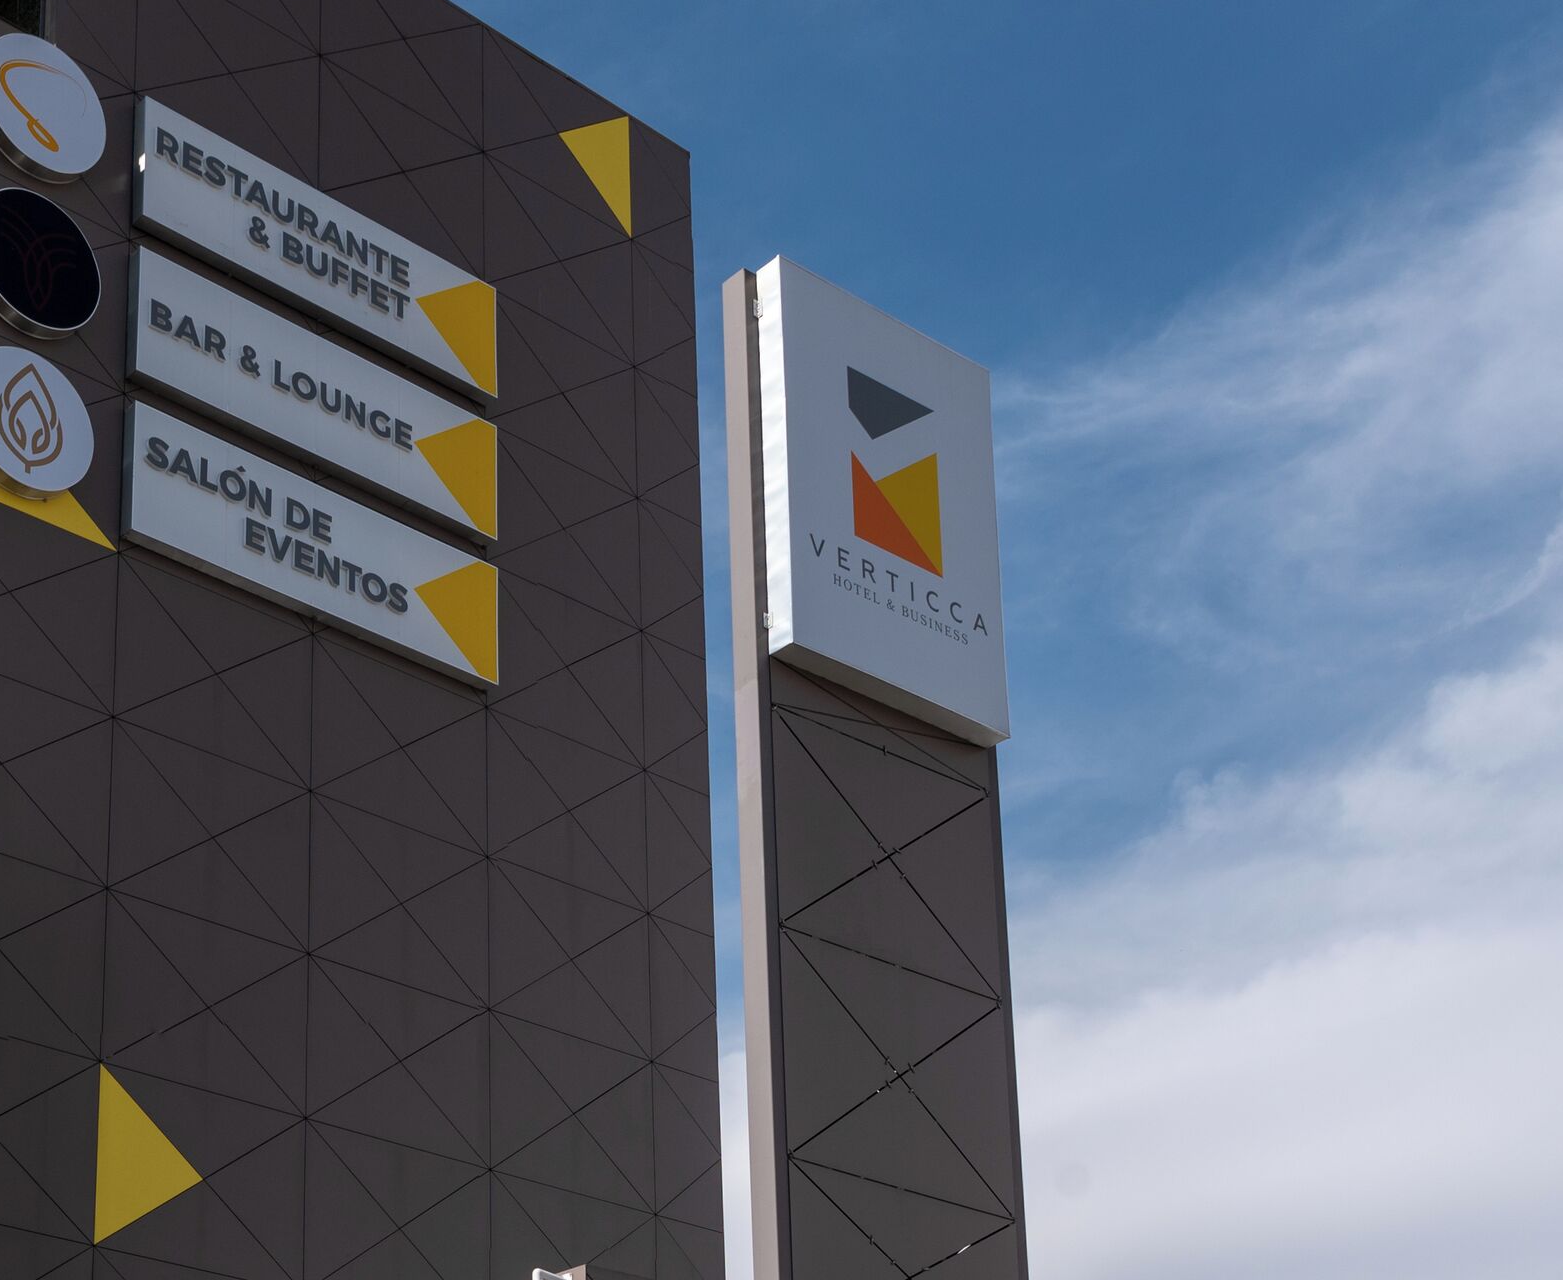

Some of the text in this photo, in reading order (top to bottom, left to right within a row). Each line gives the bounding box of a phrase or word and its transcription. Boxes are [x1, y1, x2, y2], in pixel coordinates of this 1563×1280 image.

[155, 126, 411, 289] RESTAURANTE
[247, 215, 411, 321] & BUFFET
[149, 298, 413, 452] BAR & LOUNGE
[146, 436, 333, 544] SALÓN DE
[244, 517, 409, 614] EVENTOS
[809, 533, 988, 636] VERTICCA
[833, 573, 969, 646] HOTEL & BUSINESS
